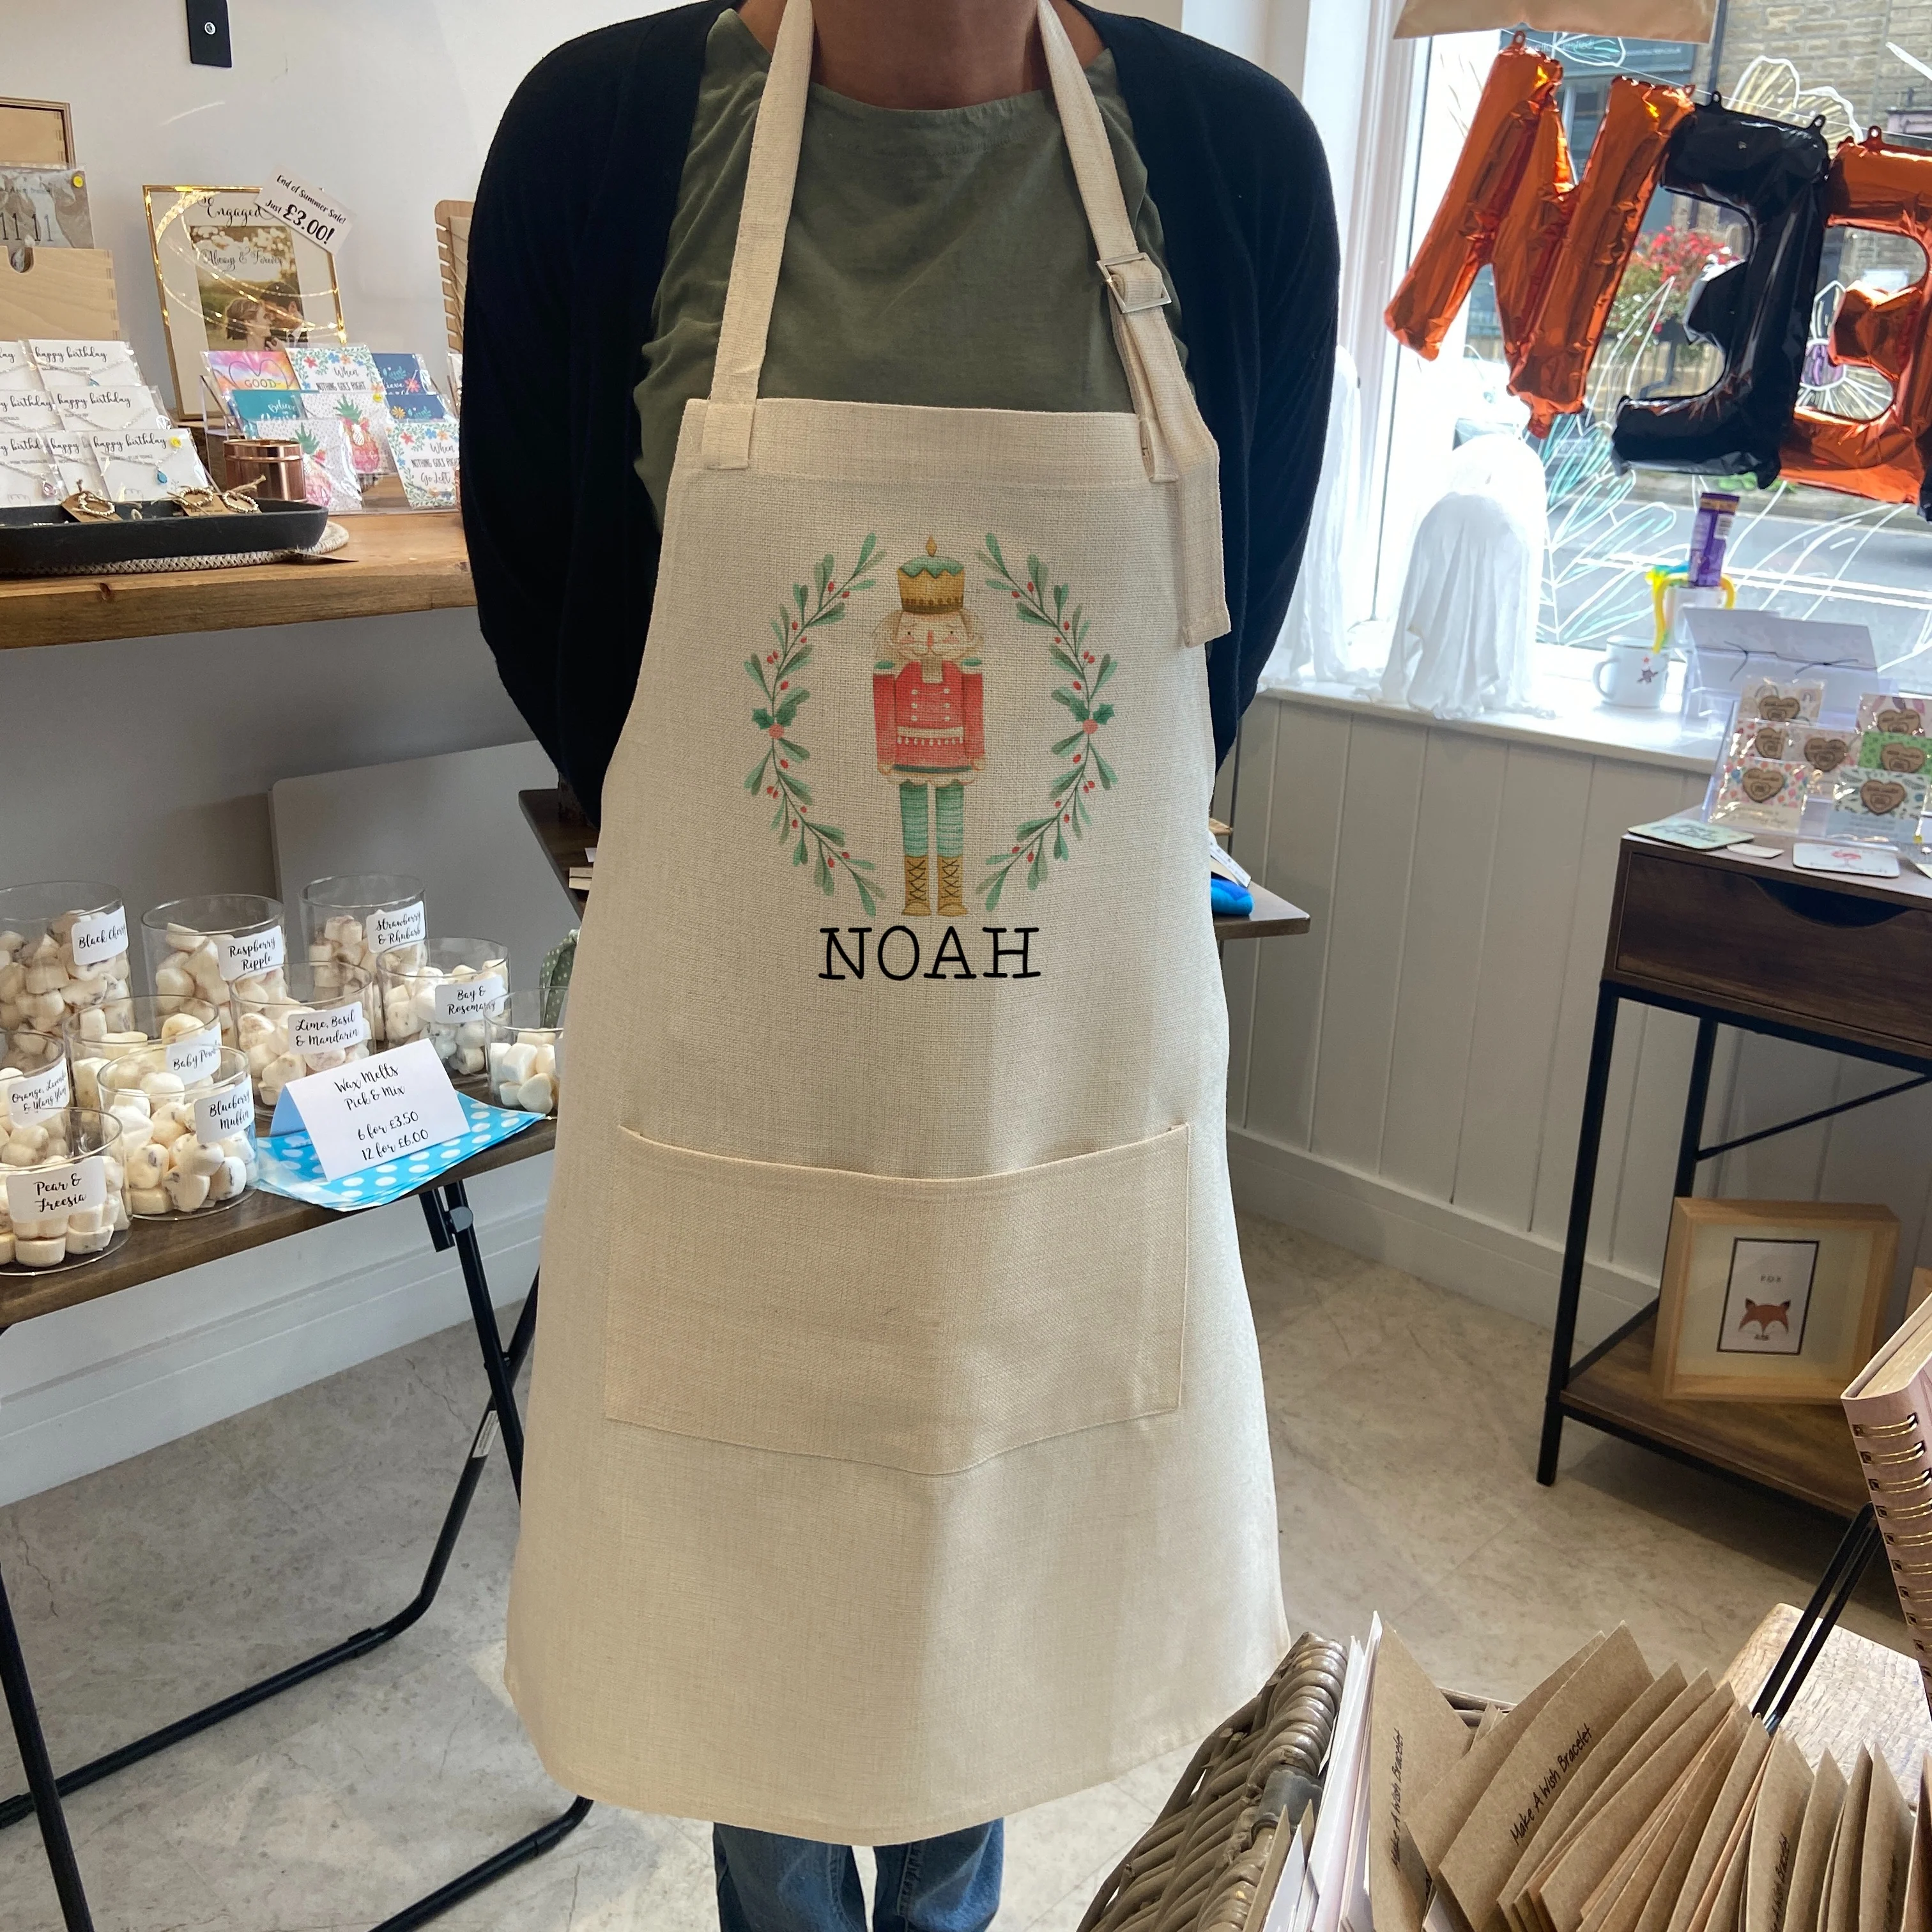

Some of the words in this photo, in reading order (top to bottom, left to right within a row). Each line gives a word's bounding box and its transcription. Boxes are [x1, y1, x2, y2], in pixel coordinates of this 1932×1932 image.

[277, 174, 293, 190] End
[291, 185, 300, 194] of
[299, 189, 328, 212] Summer
[328, 209, 346, 225] Sale!
[197, 197, 274, 228] Engaged
[265, 199, 282, 214] Just
[283, 204, 335, 245] £3.00!
[34, 346, 64, 363] happy
[66, 346, 107, 363] birthday
[334, 366, 359, 378] When
[10, 395, 54, 411] birthday
[57, 393, 88, 409] happy
[89, 392, 131, 408] birthday
[10, 438, 43, 451] birthd
[50, 438, 79, 454] happy
[93, 436, 123, 453] happy
[125, 433, 167, 450] birthday
[430, 442, 455, 454] When
[375, 911, 421, 931] Strawberry
[77, 930, 107, 949] Black
[378, 933, 386, 945] &
[388, 924, 421, 944] Rhubarb
[227, 937, 275, 958] Raspberry
[818, 925, 1041, 981] NOAH
[241, 952, 272, 970] Ripple
[457, 989, 476, 1002] Bay
[479, 985, 486, 997] &
[447, 1000, 495, 1016] Rosemary
[295, 1019, 329, 1031] Lime,
[330, 1009, 355, 1027] Basil
[296, 1035, 305, 1046] &
[309, 1029, 359, 1046] Mandarin
[172, 1054, 198, 1071] Baby
[334, 1078, 362, 1092] Wax
[360, 1062, 399, 1083] Melts
[12, 1088, 45, 1103] Orange,
[208, 1089, 250, 1117] Blueberry
[344, 1091, 371, 1111] Pick
[370, 1089, 381, 1101] &
[381, 1085, 405, 1097] Mix
[220, 1108, 249, 1130] Muffin
[358, 1128, 365, 1140] 6
[367, 1123, 388, 1139] for
[390, 1110, 418, 1130] £3.50
[362, 1147, 374, 1161] 12
[376, 1142, 396, 1158] for
[398, 1129, 429, 1148] £6.00
[33, 1181, 68, 1196] Pear
[71, 1172, 82, 1186] &
[34, 1193, 86, 1213] Freesia
[1391, 1727, 1404, 1783] Bracelet
[1558, 1722, 1592, 1773] Bracelet
[1538, 1768, 1561, 1800] Wish
[1391, 1782, 1401, 1814] Wish
[1533, 1791, 1544, 1813] A
[1390, 1811, 1400, 1832] A
[1510, 1808, 1535, 1846] Make
